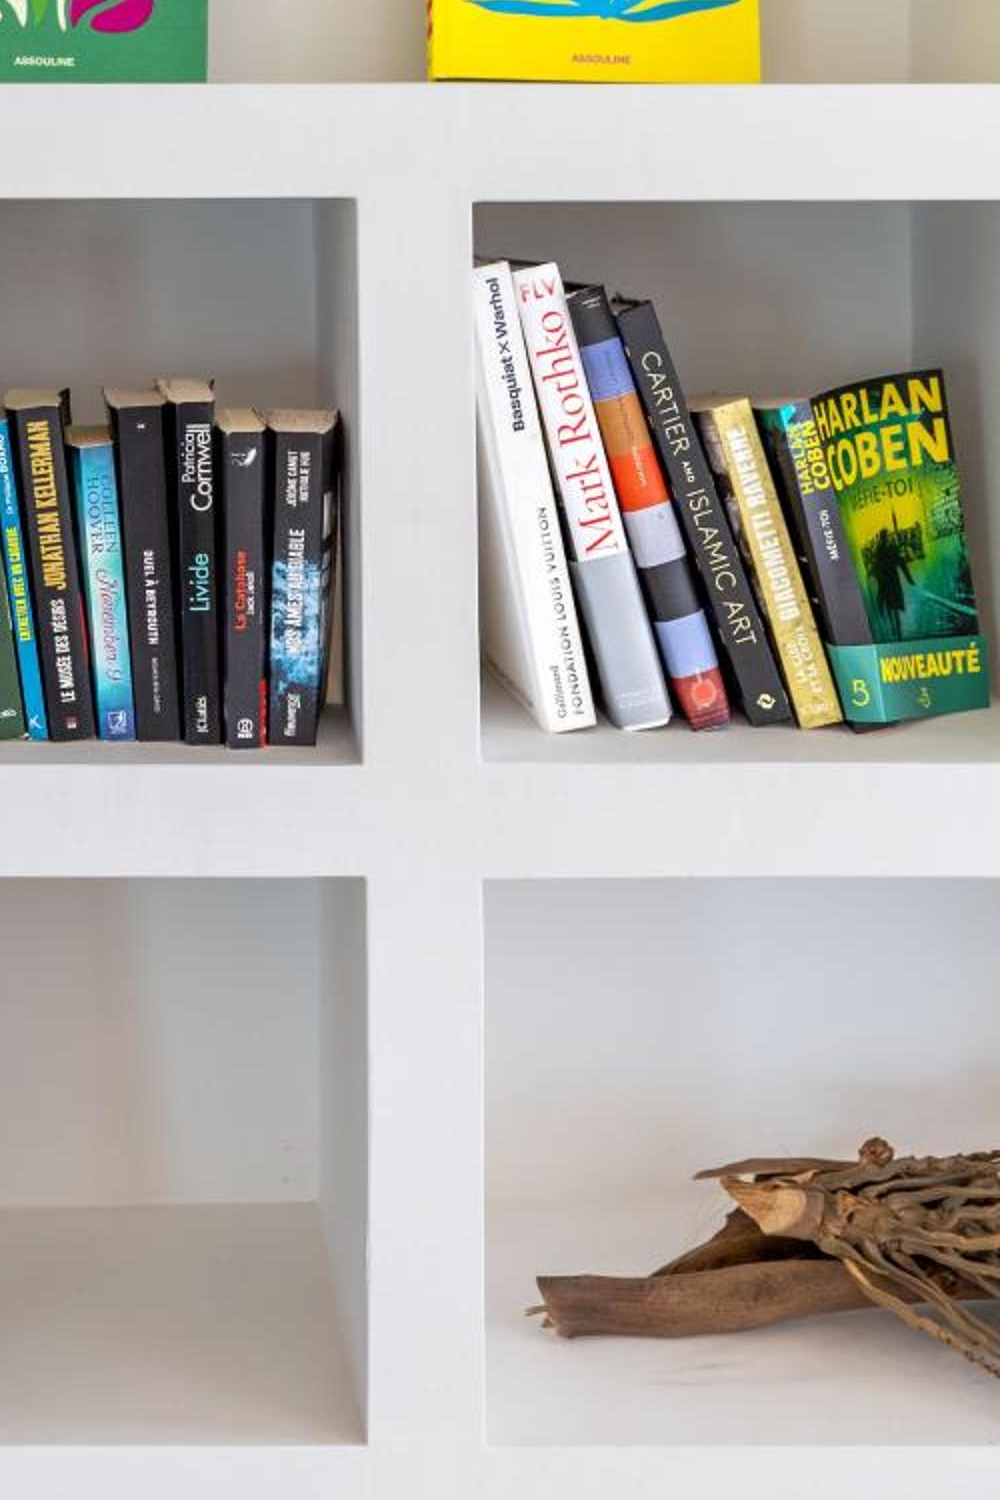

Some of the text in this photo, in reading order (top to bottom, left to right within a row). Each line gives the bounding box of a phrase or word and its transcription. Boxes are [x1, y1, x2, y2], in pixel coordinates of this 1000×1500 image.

[13, 56, 75, 67] ASSOULINE
[571, 54, 631, 65] ASSOULINE
[486, 277, 508, 339] Warhol
[520, 279, 556, 302] FLV
[502, 357, 525, 431] Basquiat
[814, 376, 943, 442] HARLAN
[182, 435, 195, 483] Patricia
[535, 310, 618, 556] Mark Rothko
[786, 424, 815, 495] HARLAN
[802, 419, 831, 490] COBEN
[826, 417, 950, 492] COBEN
[190, 423, 213, 511] Cornwell
[26, 420, 67, 590] JONATHAN KELLERMAN
[87, 475, 104, 554] HOOVER
[641, 351, 757, 646] CARTIER AND ISLAMIC ART
[143, 550, 155, 577] DUEL
[287, 528, 304, 568] DIABLE
[751, 511, 800, 622] GIACOMETTI
[189, 553, 210, 611] Livide
[287, 570, 303, 589] AU
[51, 599, 68, 632] DÉSIRS
[95, 569, 122, 682] November 9
[146, 589, 159, 645] BEYROUTH
[538, 506, 585, 715] FONDATION LOUIS VUITTON
[54, 633, 70, 653] DES
[285, 628, 301, 653] NOS
[880, 641, 982, 683] NOUVEAUTÉ
[56, 654, 74, 689] MUSÉE
[60, 690, 77, 703] LE
